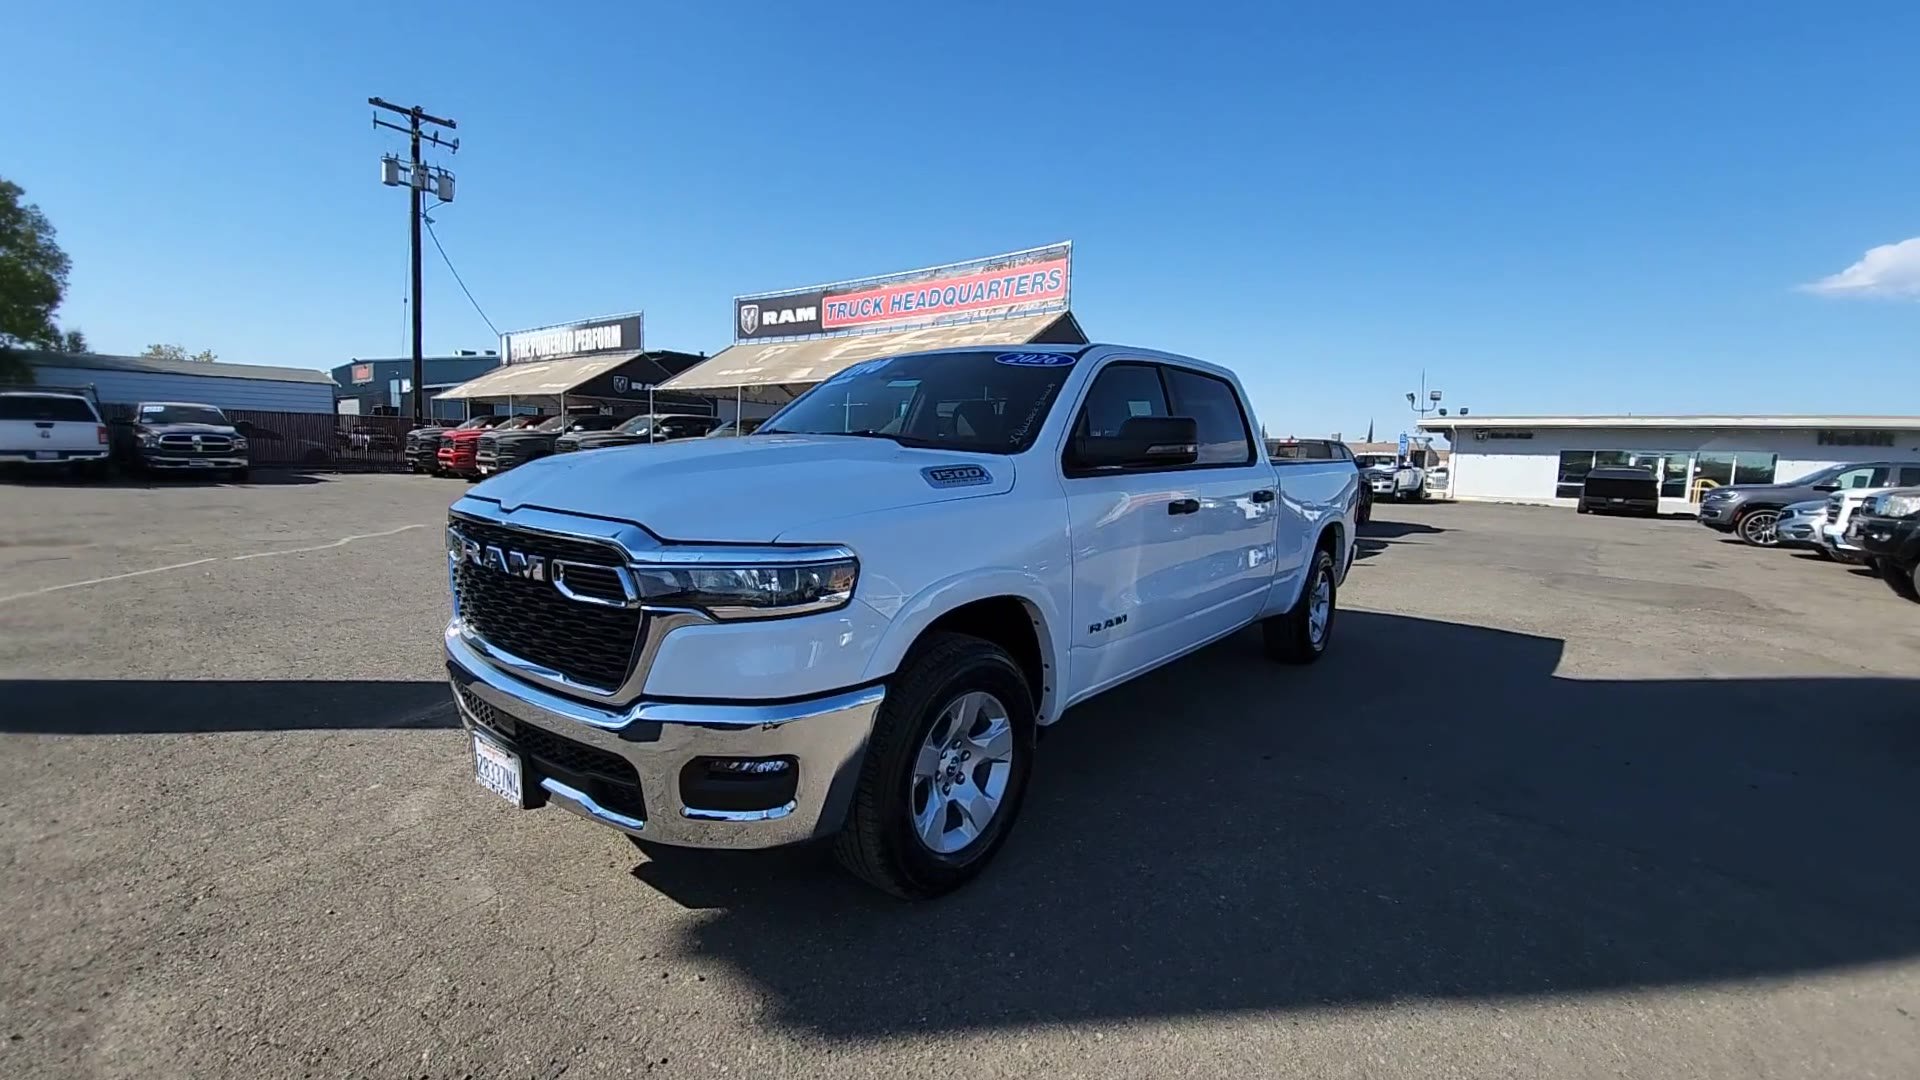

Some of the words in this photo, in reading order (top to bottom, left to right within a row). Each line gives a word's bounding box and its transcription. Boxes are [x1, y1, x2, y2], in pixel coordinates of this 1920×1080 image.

[762, 306, 817, 325] RAM
[825, 296, 885, 320] TRUCK
[890, 269, 1063, 313] HEADQUARTERS
[575, 324, 621, 352] PERFORM
[1006, 354, 1059, 364] 2026
[631, 381, 653, 391] RA
[933, 468, 981, 480] 1500
[460, 536, 546, 581] RAM
[1088, 614, 1127, 634] RAM
